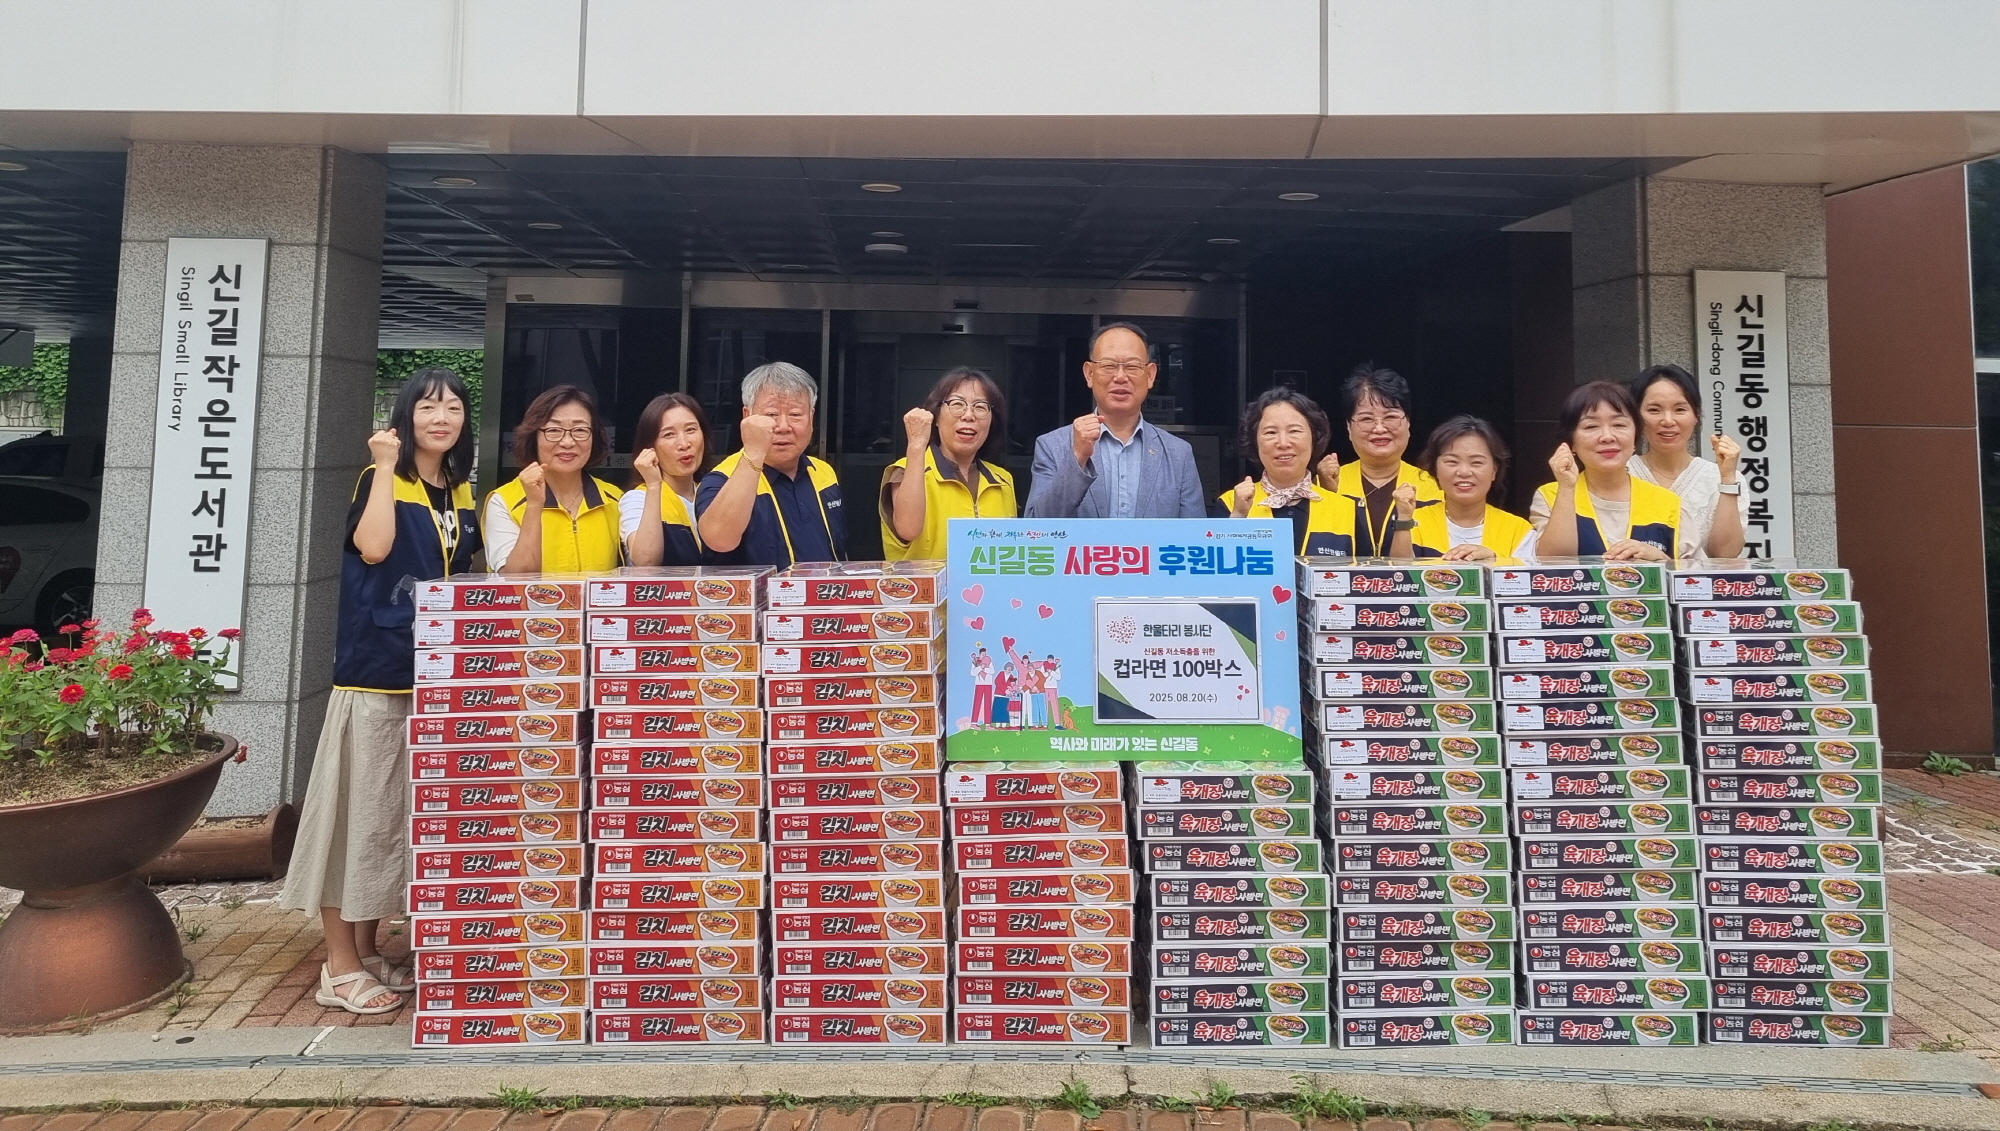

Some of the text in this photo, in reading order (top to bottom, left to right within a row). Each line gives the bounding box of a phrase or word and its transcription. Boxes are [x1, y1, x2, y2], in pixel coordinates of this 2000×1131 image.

[1708, 302, 1724, 376] Singil-dong
[167, 266, 196, 433] Singil Small Library
[189, 264, 242, 573] 신길작은도서관
[1050, 530, 1069, 539] 안산
[969, 544, 1274, 576] 신길동 사랑의 후원나눔
[817, 582, 848, 601] 김치
[848, 588, 875, 599] 사발면
[1532, 574, 1574, 593] 육개장
[1574, 580, 1602, 591] 사발면
[465, 588, 496, 607] 김치
[496, 594, 522, 604] 사발면
[635, 617, 694, 636] 김치 사발면
[1358, 609, 1427, 628] 육개장 사발면
[1767, 618, 1794, 629] 사발면
[1142, 623, 1213, 638] 한울타리 봉사단
[811, 650, 869, 668] 김치 사발면
[1143, 647, 1216, 656] 신길동 저소득층을 위한
[1584, 648, 1611, 658] 사발면
[464, 655, 495, 674] 김치
[495, 662, 521, 671] 사발면
[1113, 659, 1243, 680] 컵라면 100박스
[610, 684, 628, 693] 농심
[639, 682, 697, 701] 김치 사발면
[1149, 692, 1219, 704] 2025.08.20(수)
[1402, 684, 1429, 694] 사발면
[1734, 680, 1805, 699] 육개장 사발면
[788, 718, 806, 727] 농심
[817, 715, 876, 734] 김치 사발면
[1546, 708, 1615, 726] 육개장 사발면
[456, 719, 514, 738] 김치 사발면
[1050, 737, 1199, 752] 역사와 미래가 있는 신길동
[1368, 743, 1438, 762] 육개장 사발면
[641, 750, 699, 770] 김치 사발면
[1742, 747, 1814, 766] 육개장 사발면
[432, 790, 450, 799] 농심
[818, 782, 876, 801] 김치 사발면
[1181, 781, 1251, 800] 육개장 사발면
[1555, 776, 1626, 796] 육개장 사발면
[461, 787, 520, 806] 김치 사발면
[609, 818, 626, 826] 농심
[637, 814, 696, 834] 김치 사발면
[1002, 810, 1062, 830] 김치 사발면
[1349, 812, 1367, 821] 농심
[1373, 812, 1443, 831] 육개장 사발면
[1711, 812, 1730, 821] 농심
[1736, 813, 1810, 832] 육개장 사발면
[791, 852, 808, 860] 농심
[820, 848, 879, 867] 김치 사발면
[1187, 848, 1257, 868] 육개장 사발면
[1540, 846, 1557, 855] 농심
[1563, 845, 1635, 865] 육개장 사발면
[463, 853, 522, 872] 김치 사발면
[642, 885, 701, 904] 김치 사발면
[979, 882, 997, 891] 농심
[1009, 879, 1069, 898] 김치 사발면
[1375, 881, 1445, 900] 육개장 사발면
[1745, 884, 1818, 904] 육개장 사발면
[432, 924, 451, 933] 농심
[462, 920, 522, 940] 김치 사발면
[823, 916, 882, 935] 김치 사발면
[1172, 917, 1189, 926] 농심
[1196, 917, 1265, 936] 육개장 사발면
[1563, 915, 1634, 934] 육개장 사발면
[606, 953, 624, 962] 농심
[635, 950, 694, 970] 김치 사발면
[1006, 947, 1066, 966] 김치 사발면
[1357, 948, 1374, 957] 농심
[1380, 948, 1450, 968] 육개장 사발면
[1729, 954, 1748, 963] 농심
[1754, 955, 1826, 974] 육개장 사발면
[466, 985, 525, 1004] 김치 사발면
[793, 986, 810, 994] 농심
[823, 983, 883, 1002] 김치 사발면
[1549, 985, 1566, 994] 농심
[1573, 985, 1646, 1004] 육개장 사발면
[1194, 990, 1265, 1010] 육개장 사발면
[642, 1017, 702, 1036] 김치 사발면
[974, 1018, 993, 1027] 농심
[1005, 1016, 1065, 1036] 김치 사발면
[1381, 1022, 1451, 1042] 육개장 사발면
[1749, 1020, 1821, 1040] 육개장 사발면
